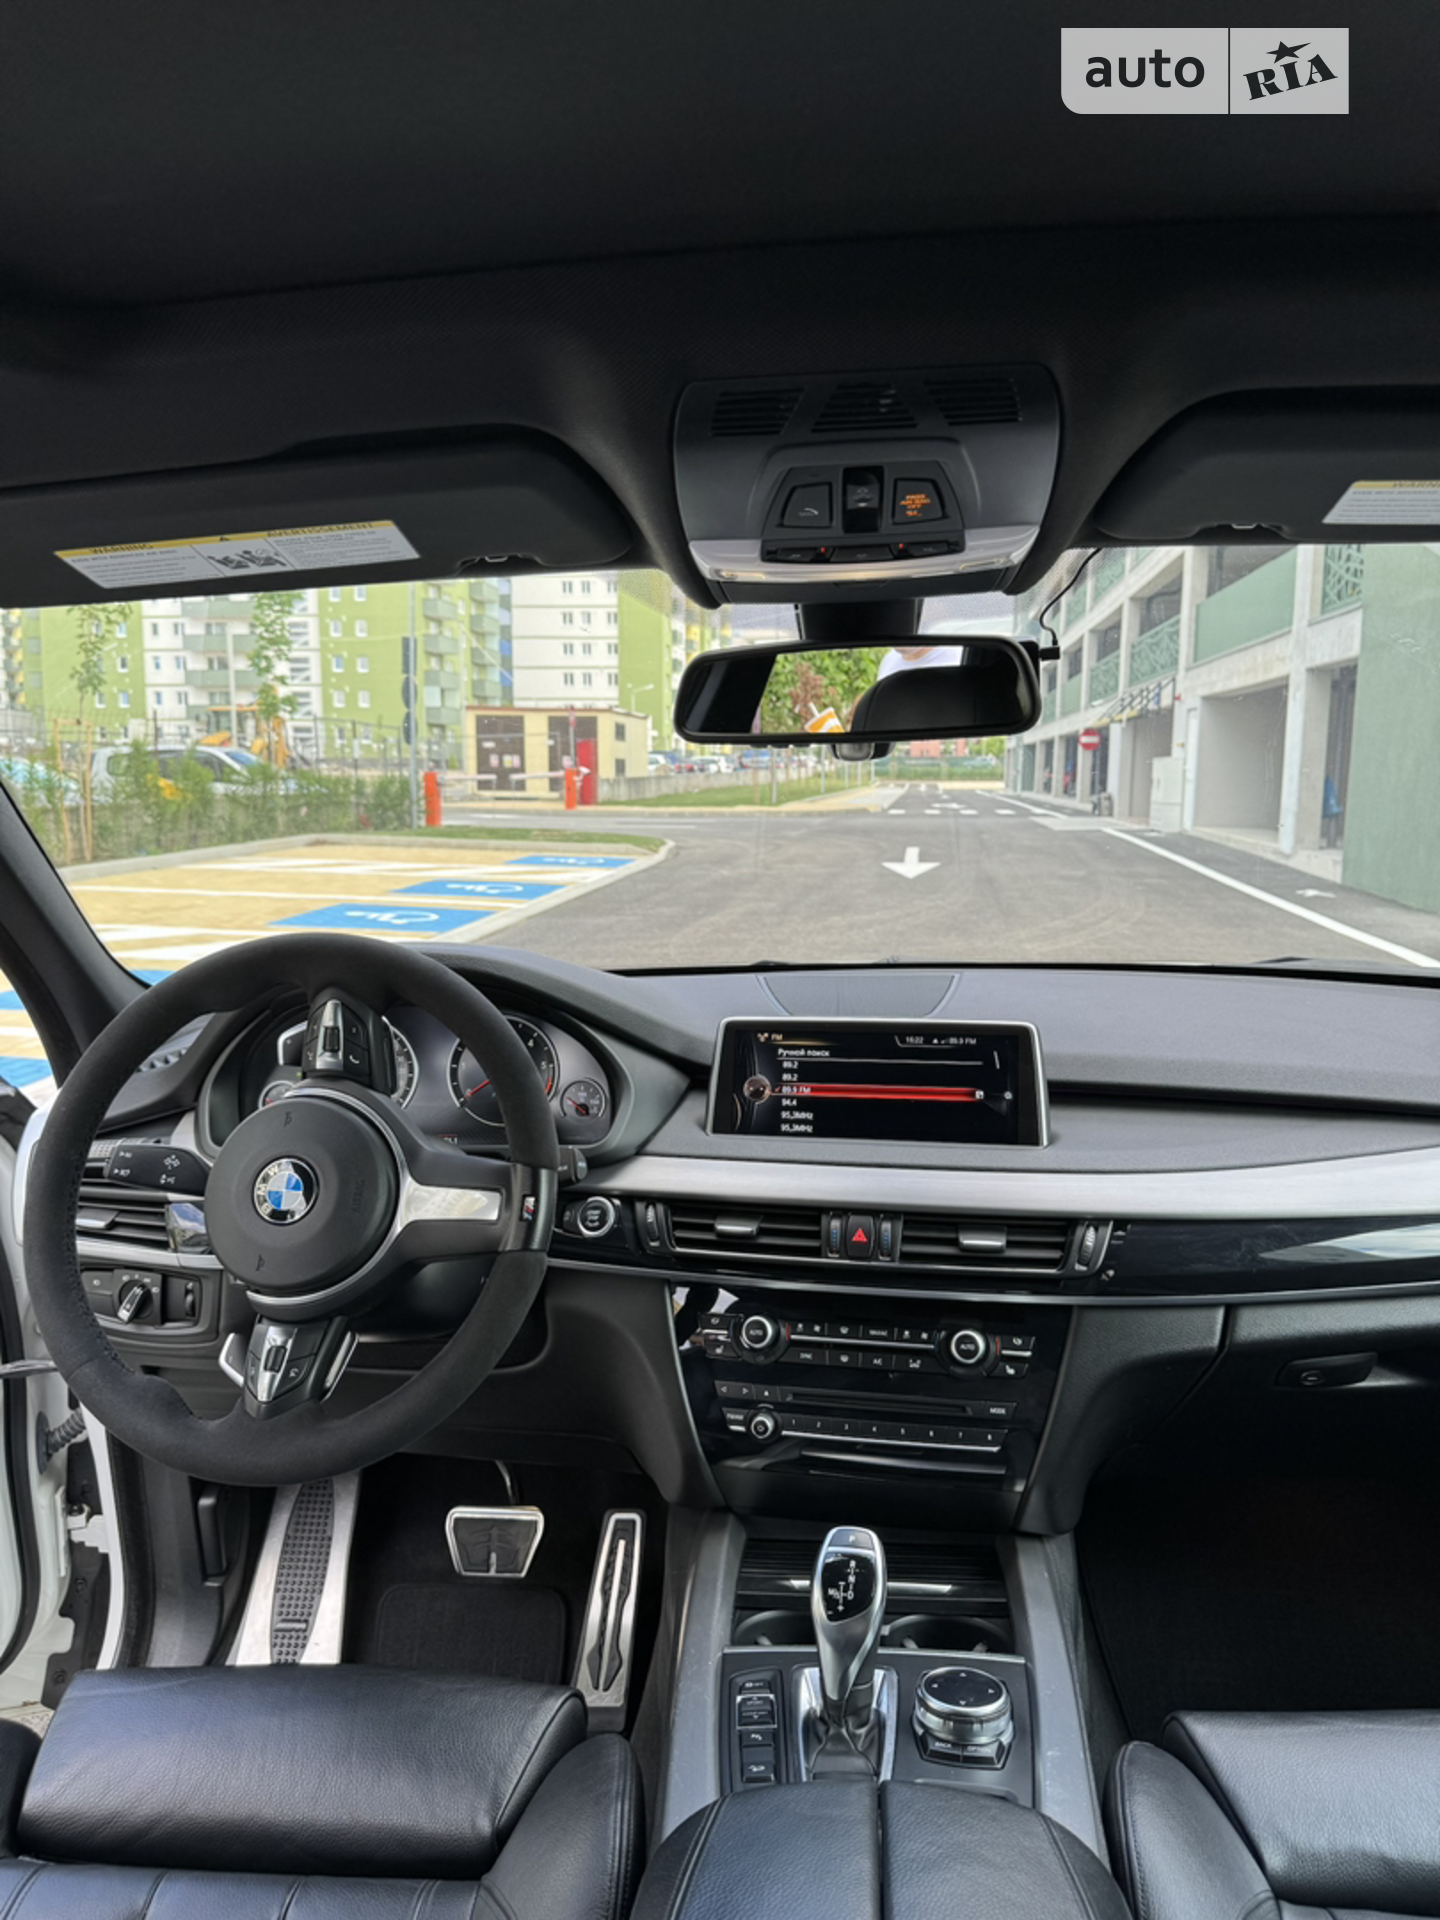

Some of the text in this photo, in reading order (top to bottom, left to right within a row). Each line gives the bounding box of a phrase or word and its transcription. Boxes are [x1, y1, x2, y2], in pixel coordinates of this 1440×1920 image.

[777, 1047, 830, 1057] Ручной поиск
[960, 1343, 975, 1351] AUTO
[989, 1407, 1007, 1415] MODE
[849, 1560, 856, 1568] R
[847, 1575, 856, 1583] N
[934, 1741, 952, 1749] BACK
[966, 1745, 992, 1754] OPTION
